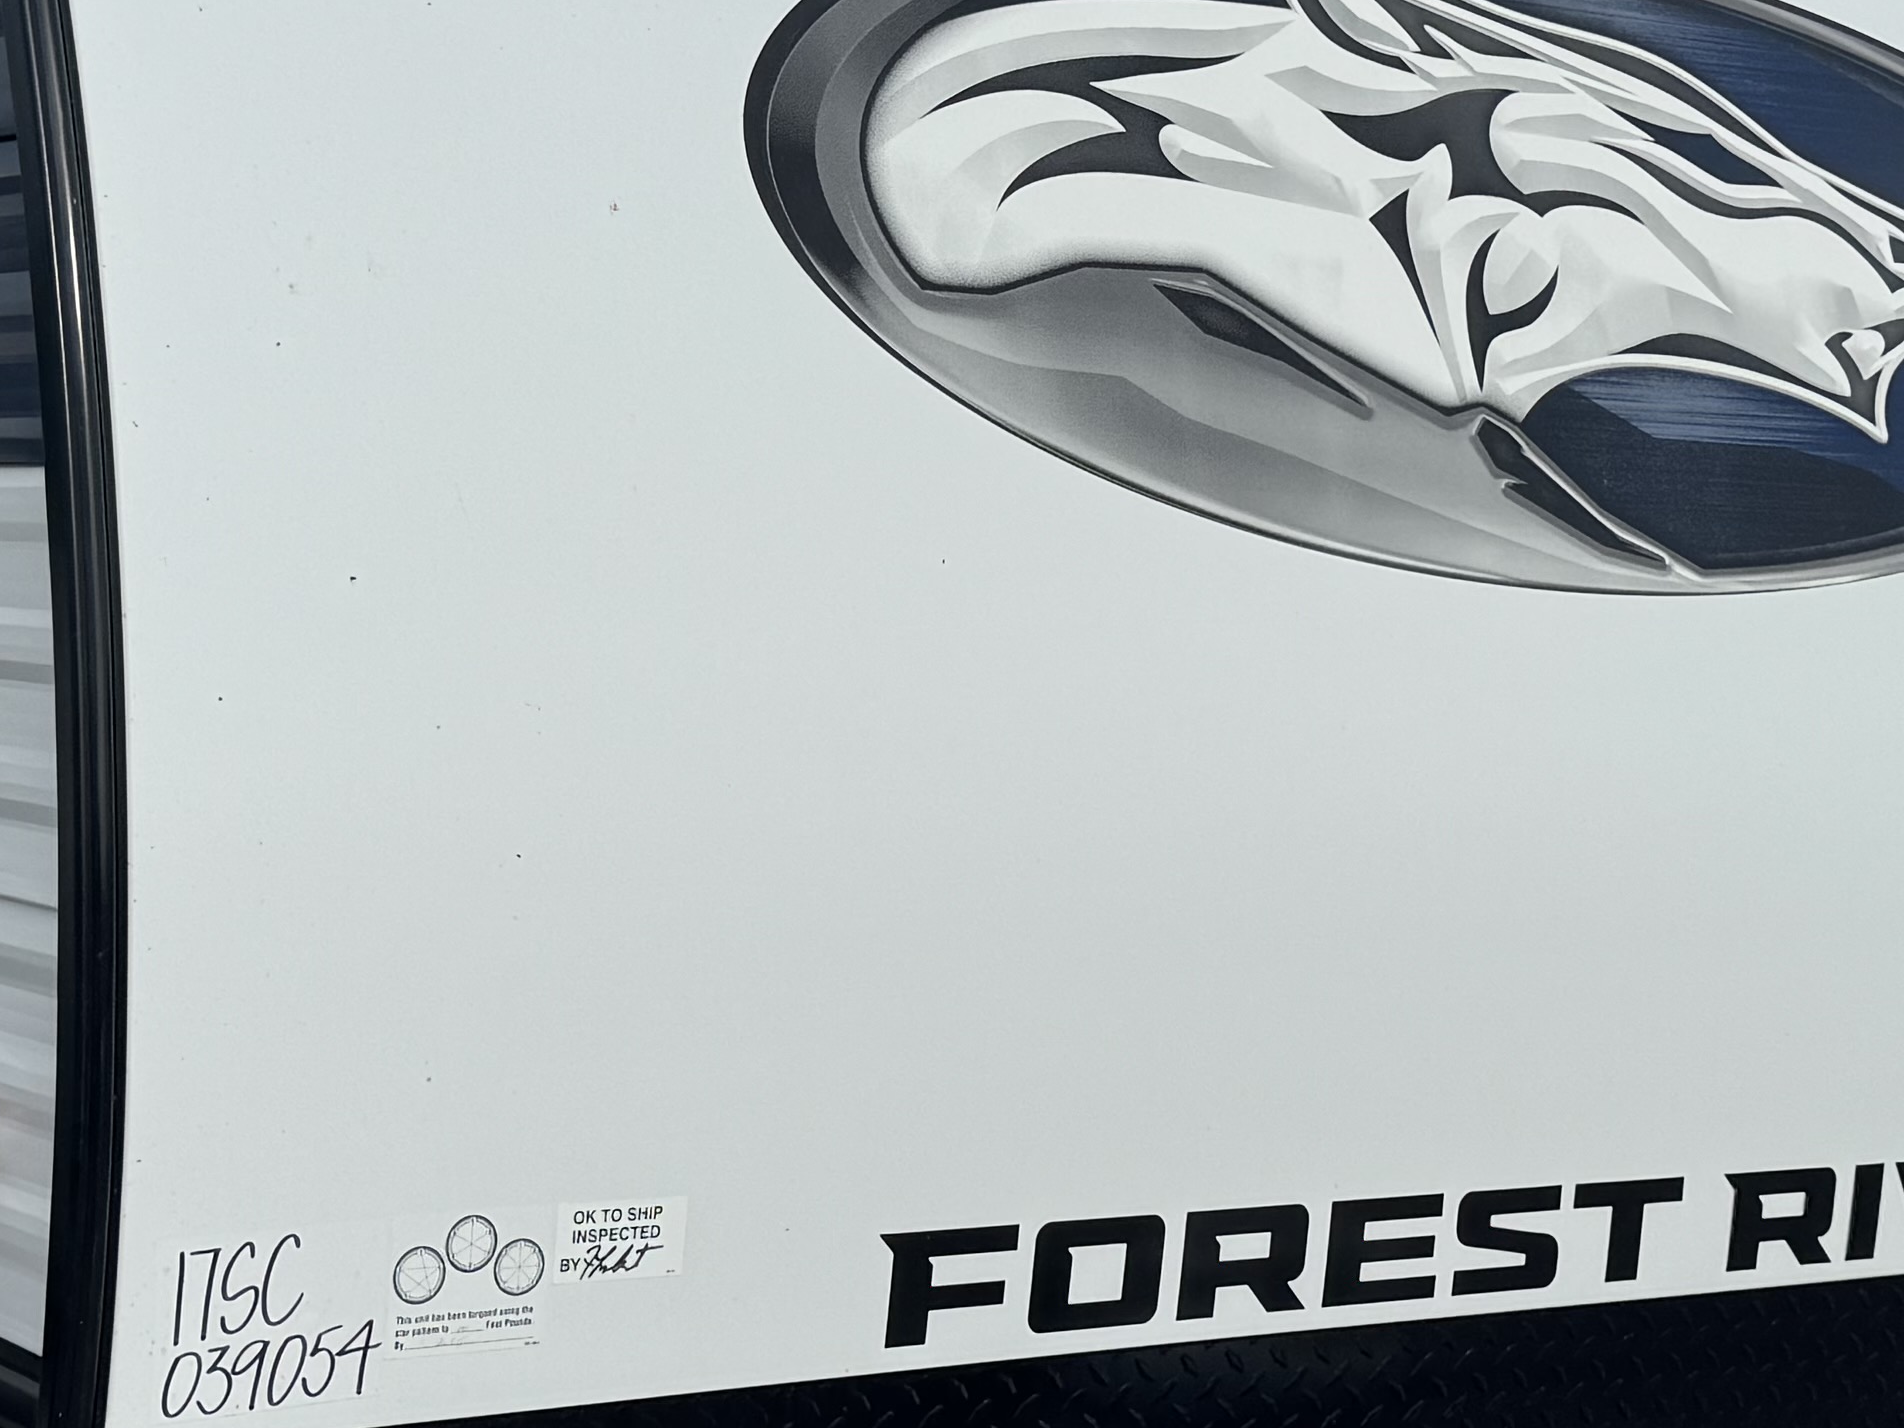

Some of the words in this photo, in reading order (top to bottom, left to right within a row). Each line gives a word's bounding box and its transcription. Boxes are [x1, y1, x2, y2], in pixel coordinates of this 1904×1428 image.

[573, 1209, 597, 1225] OK
[601, 1208, 623, 1222] TO
[627, 1205, 663, 1221] SHIP
[572, 1225, 661, 1244] INSPECTED
[560, 1257, 581, 1273] BY
[879, 1176, 1685, 1350] FOREST
[160, 1319, 382, 1419] 039054
